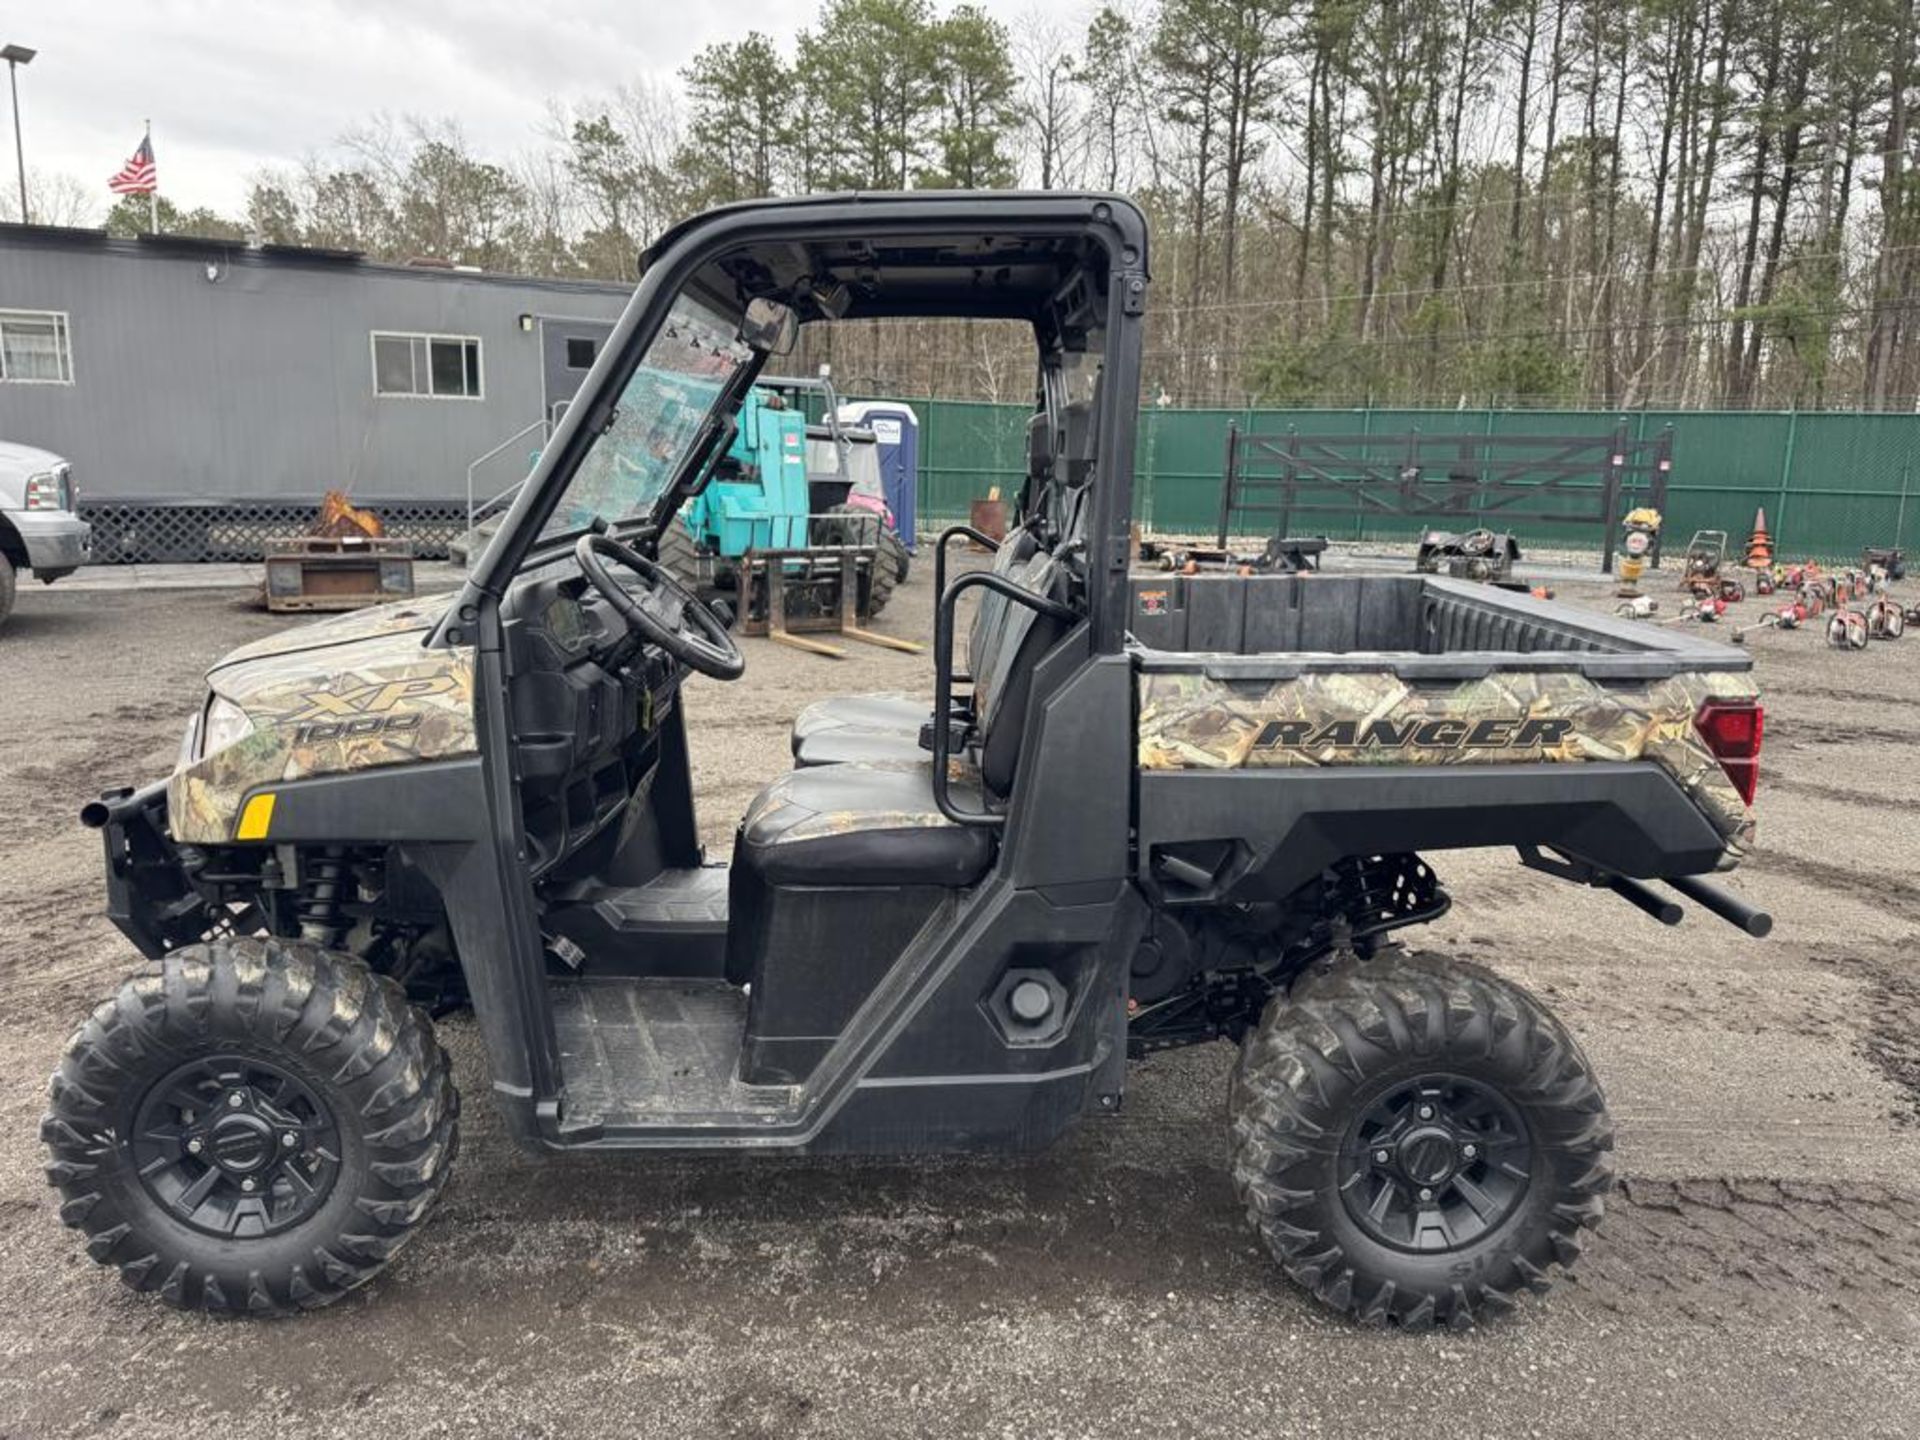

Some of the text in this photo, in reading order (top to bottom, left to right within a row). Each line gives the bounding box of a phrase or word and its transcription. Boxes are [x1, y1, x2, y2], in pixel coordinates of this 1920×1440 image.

[275, 674, 458, 724] XP
[295, 712, 423, 744] 1000
[1251, 719, 1575, 749] RANGER
